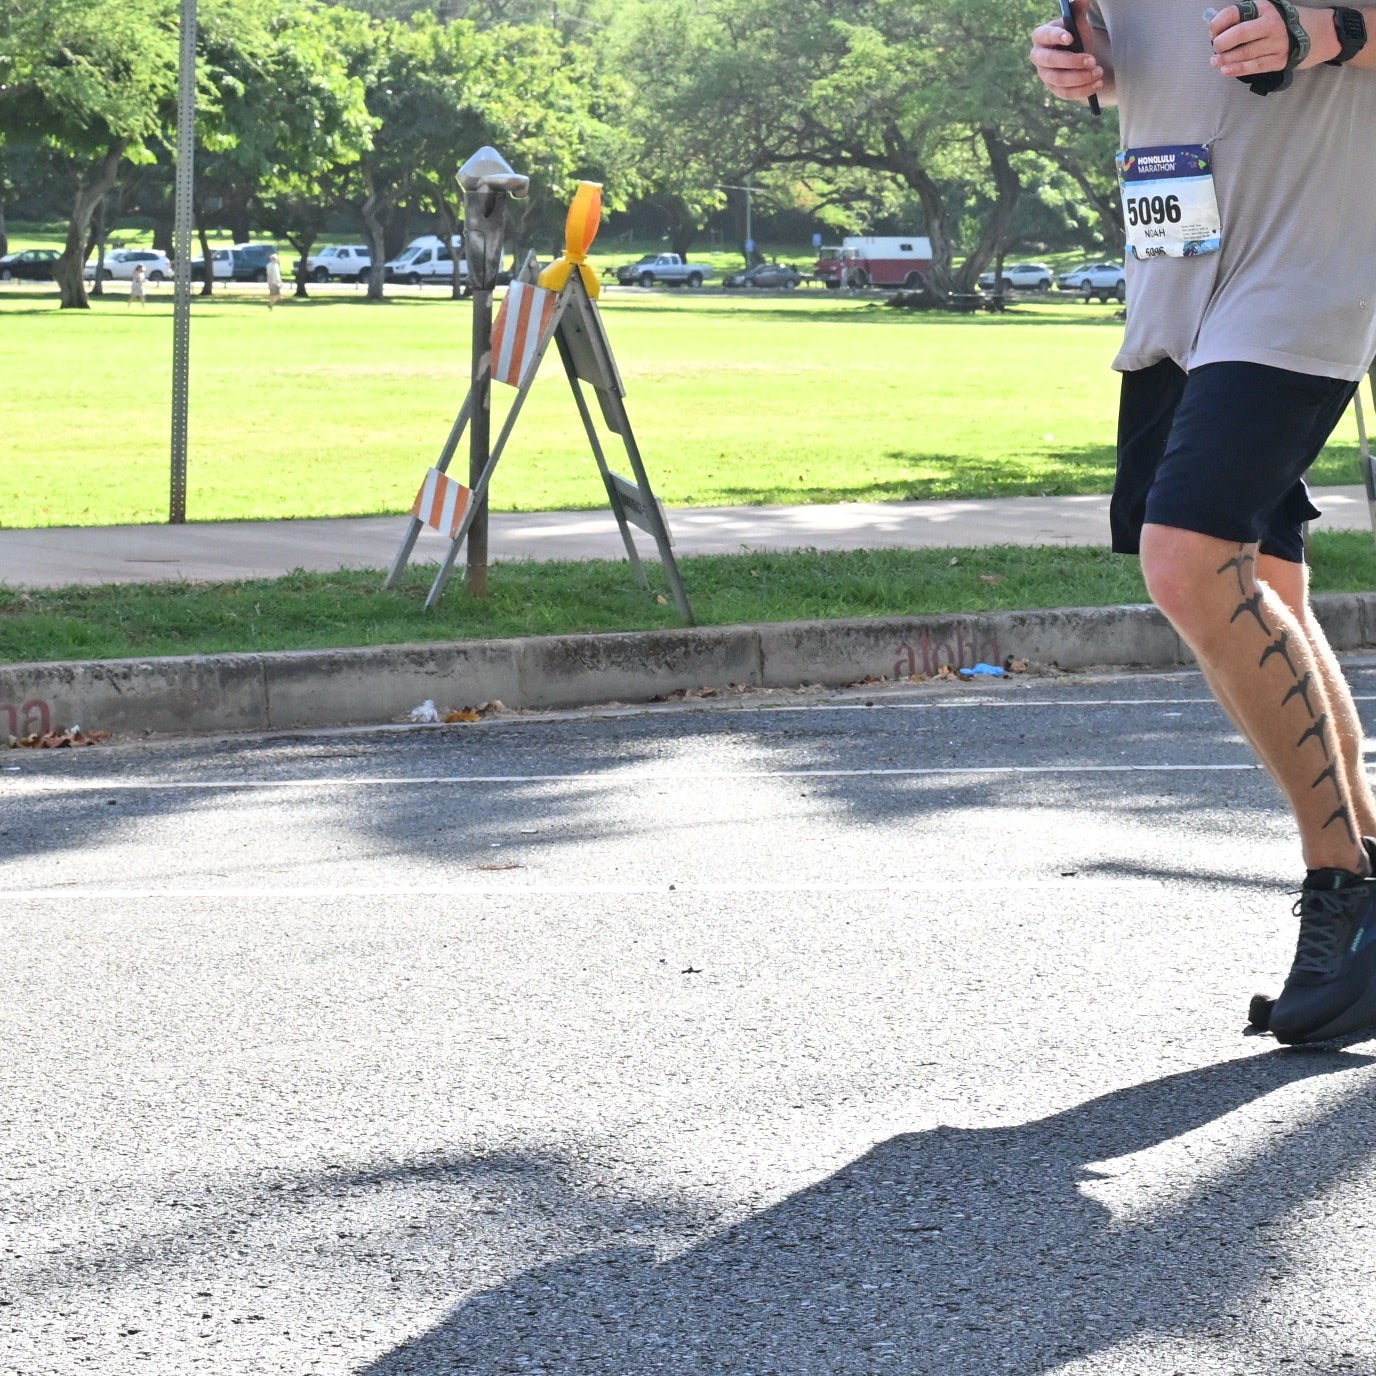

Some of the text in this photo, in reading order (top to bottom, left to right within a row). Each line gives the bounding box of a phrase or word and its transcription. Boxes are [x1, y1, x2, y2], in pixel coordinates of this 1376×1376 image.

[1137, 154, 1175, 165] HONOLULU
[1138, 163, 1175, 174] MARATHON
[1127, 194, 1181, 226] 5096
[1145, 228, 1165, 238] NOAH
